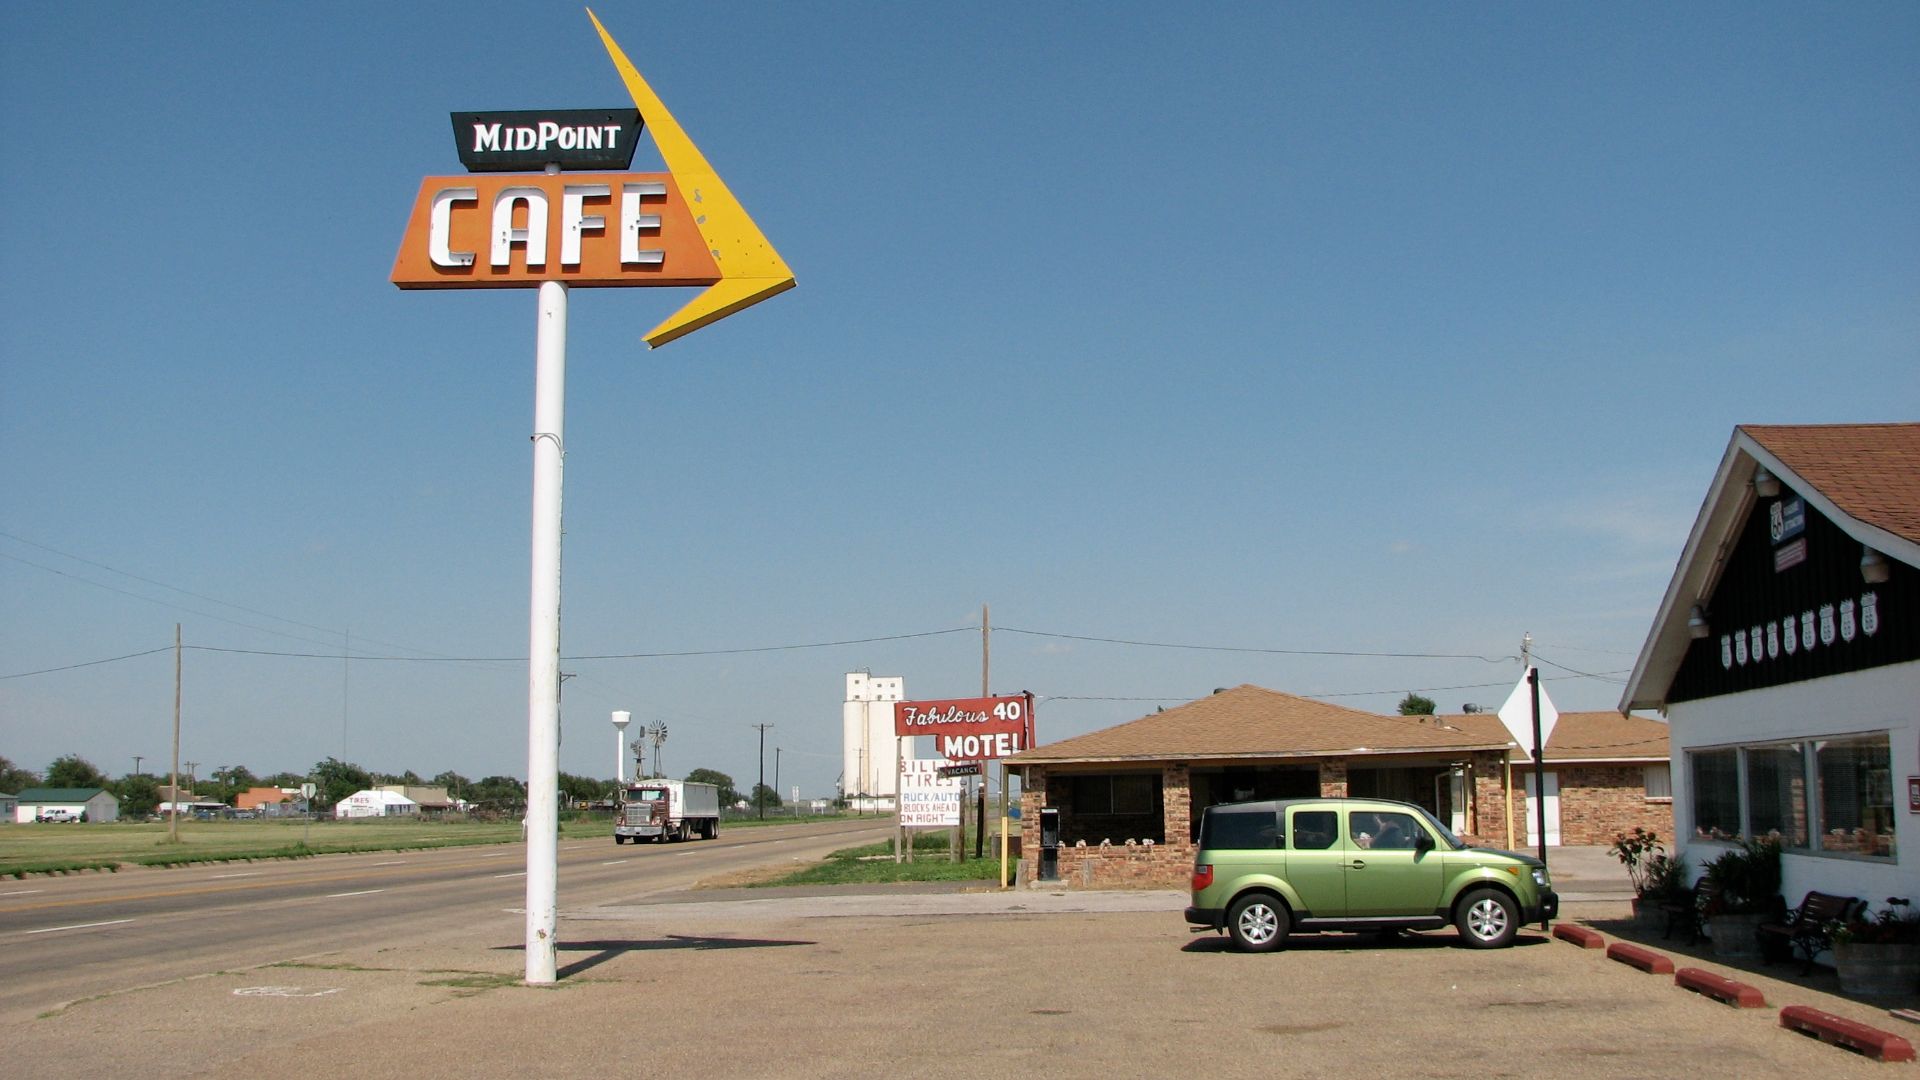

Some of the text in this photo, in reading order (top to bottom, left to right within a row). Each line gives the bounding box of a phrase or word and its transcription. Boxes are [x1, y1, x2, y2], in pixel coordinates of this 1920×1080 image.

[429, 182, 667, 267] CAFE
[903, 701, 1021, 726] Fabulous 40
[944, 733, 1021, 758] MOTEL
[947, 766, 978, 775] VACANCY
[900, 792, 960, 802] RUCK/AUTO
[903, 802, 930, 813] BLOCKS
[932, 802, 957, 812] AHEAD
[916, 813, 945, 823] RIGHT
